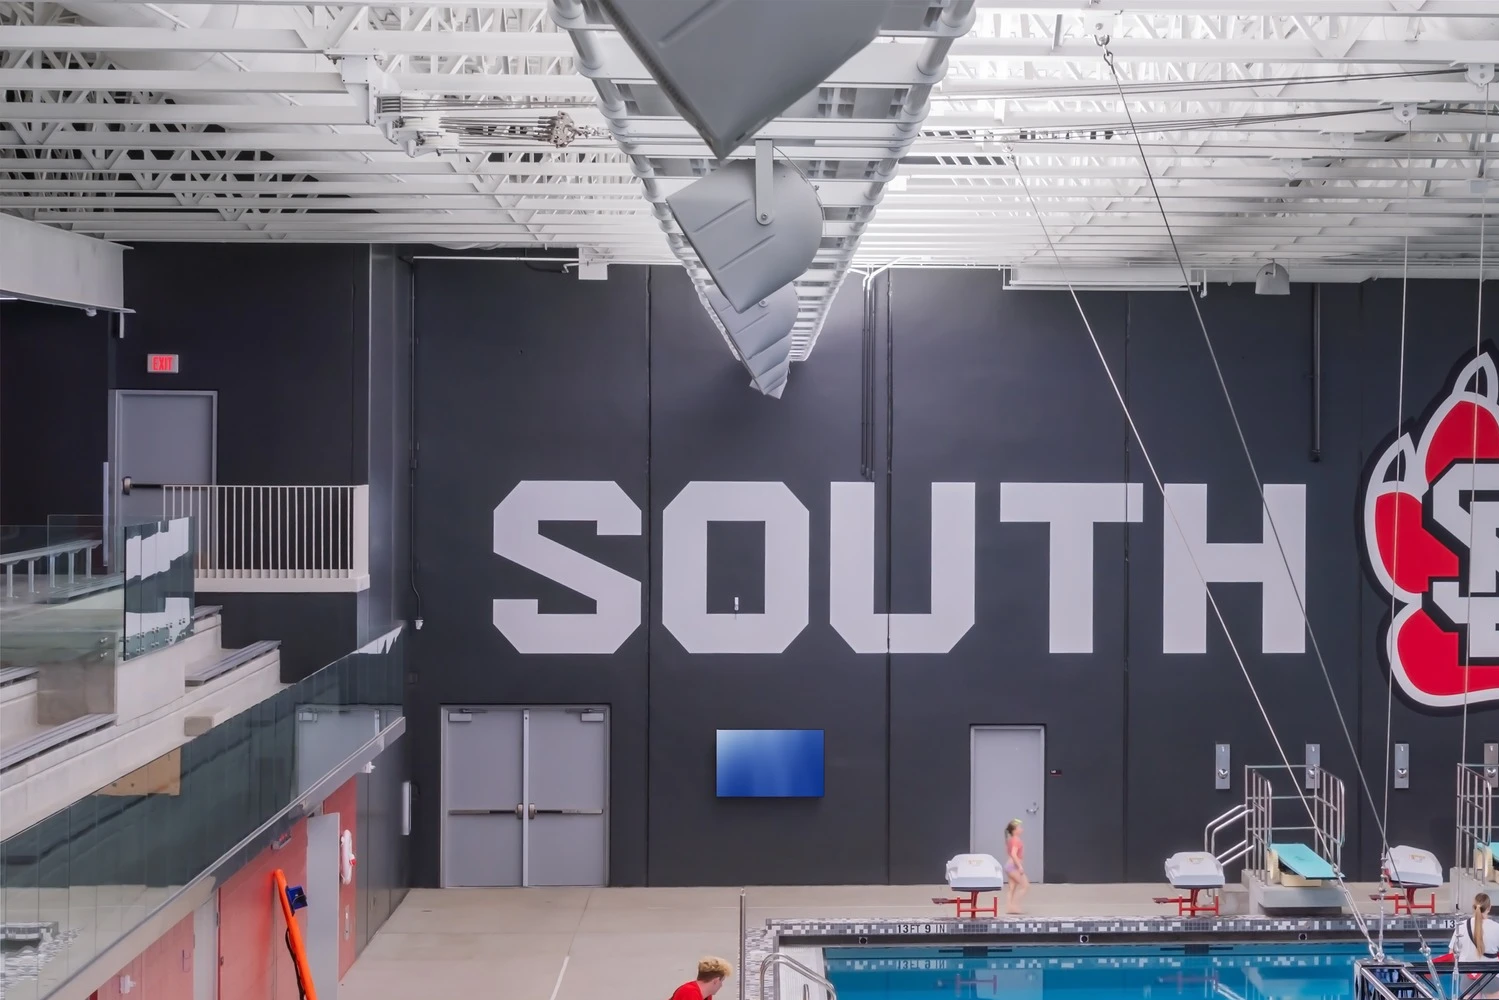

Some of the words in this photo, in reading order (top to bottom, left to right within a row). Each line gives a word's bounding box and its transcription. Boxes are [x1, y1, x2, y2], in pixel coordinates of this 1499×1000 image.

[152, 355, 173, 371] EXIT
[493, 481, 1307, 654] SOUTH
[898, 924, 920, 933] 13FT
[925, 924, 931, 933] 9
[936, 924, 945, 933] IN
